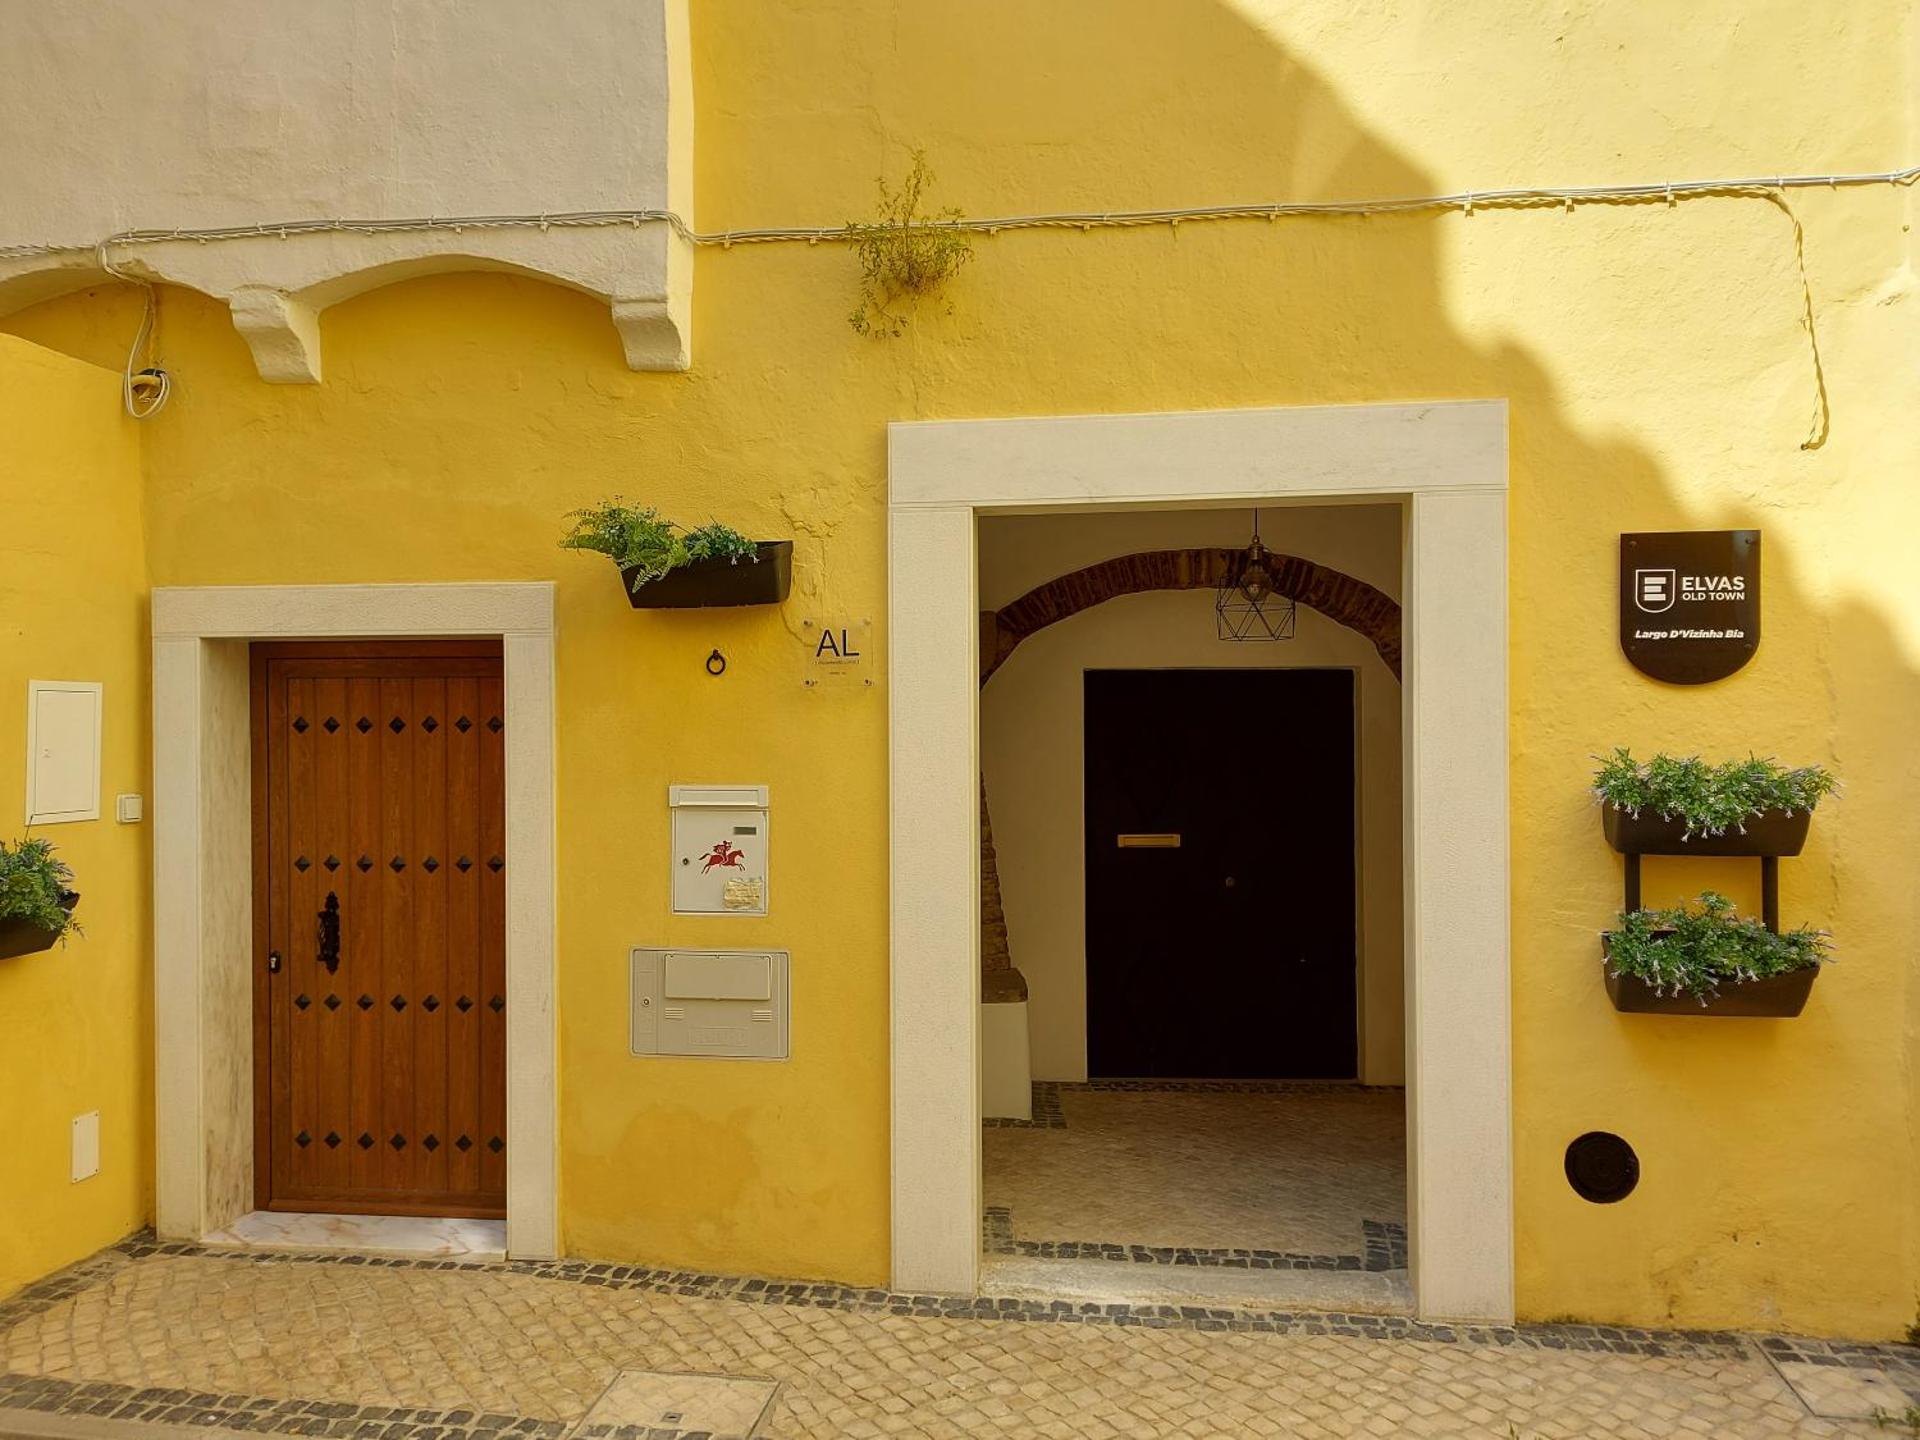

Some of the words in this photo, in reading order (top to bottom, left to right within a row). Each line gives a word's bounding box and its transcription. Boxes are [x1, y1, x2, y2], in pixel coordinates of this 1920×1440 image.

[1682, 576, 1745, 591] ELVAS
[1682, 592, 1706, 601] OLD
[1708, 592, 1745, 601] TOWN
[1635, 629, 1668, 640] Largo
[1725, 629, 1744, 639] Bia
[816, 629, 860, 657] AL
